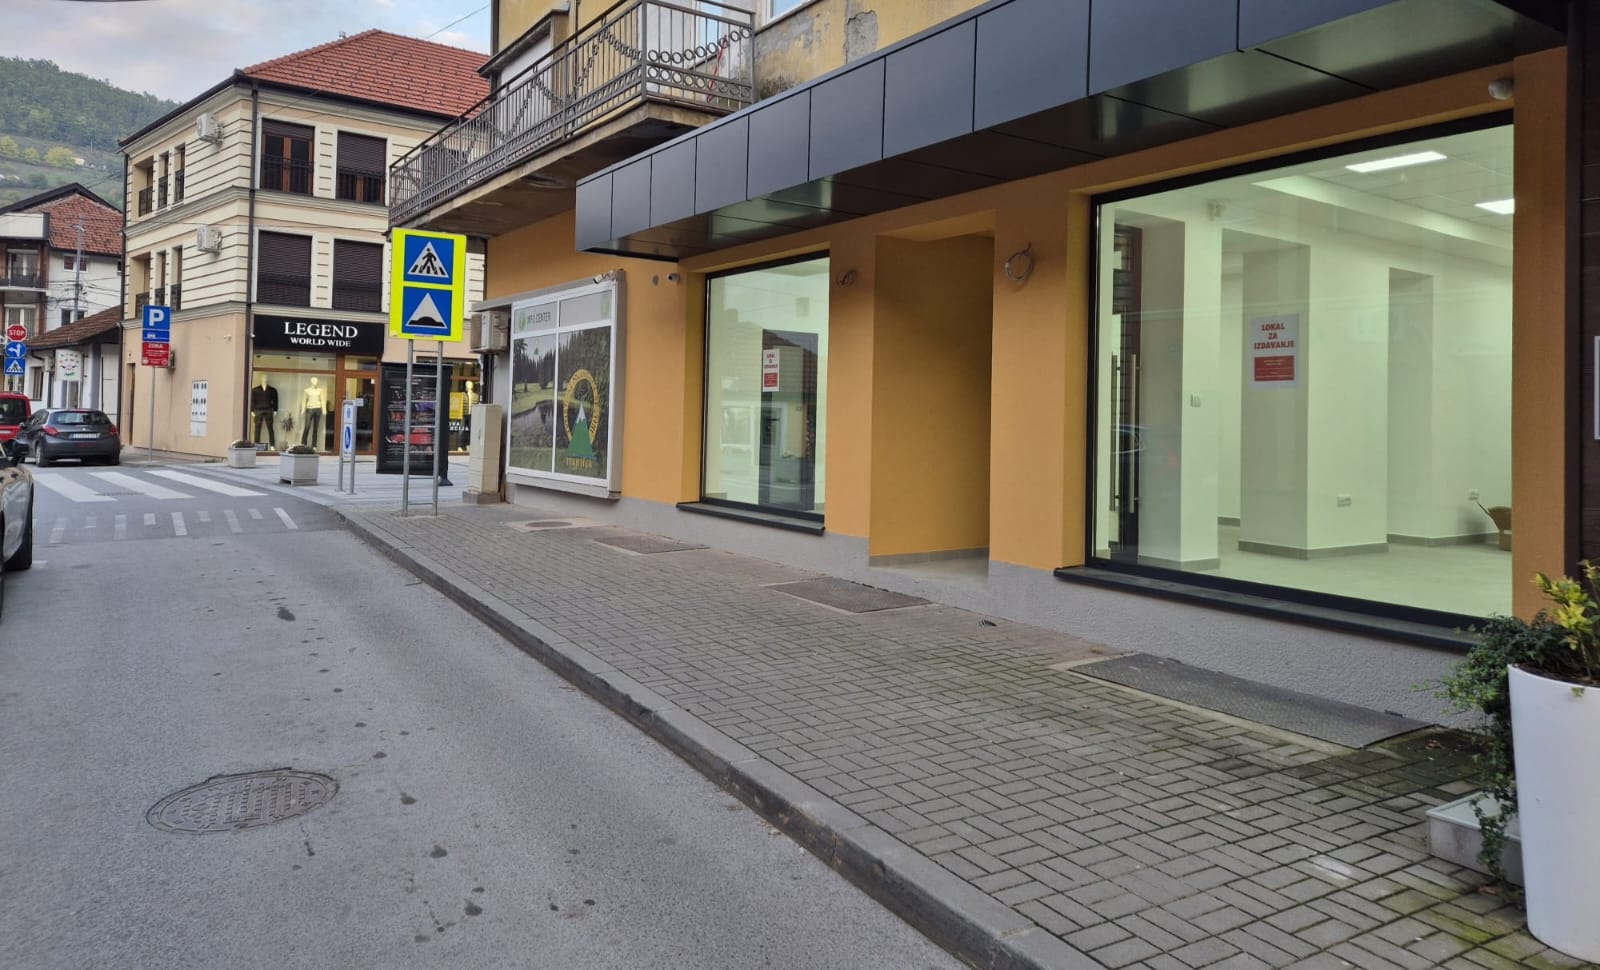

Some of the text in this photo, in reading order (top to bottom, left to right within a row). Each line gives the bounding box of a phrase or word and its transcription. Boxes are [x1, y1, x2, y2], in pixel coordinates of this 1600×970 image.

[149, 309, 164, 326] P
[284, 321, 358, 338] LEGEND
[1261, 322, 1285, 331] LOKAL
[1268, 332, 1278, 340] ZA
[290, 336, 351, 347] WORLD WIDE
[1254, 340, 1294, 350] IZDAVANJE
